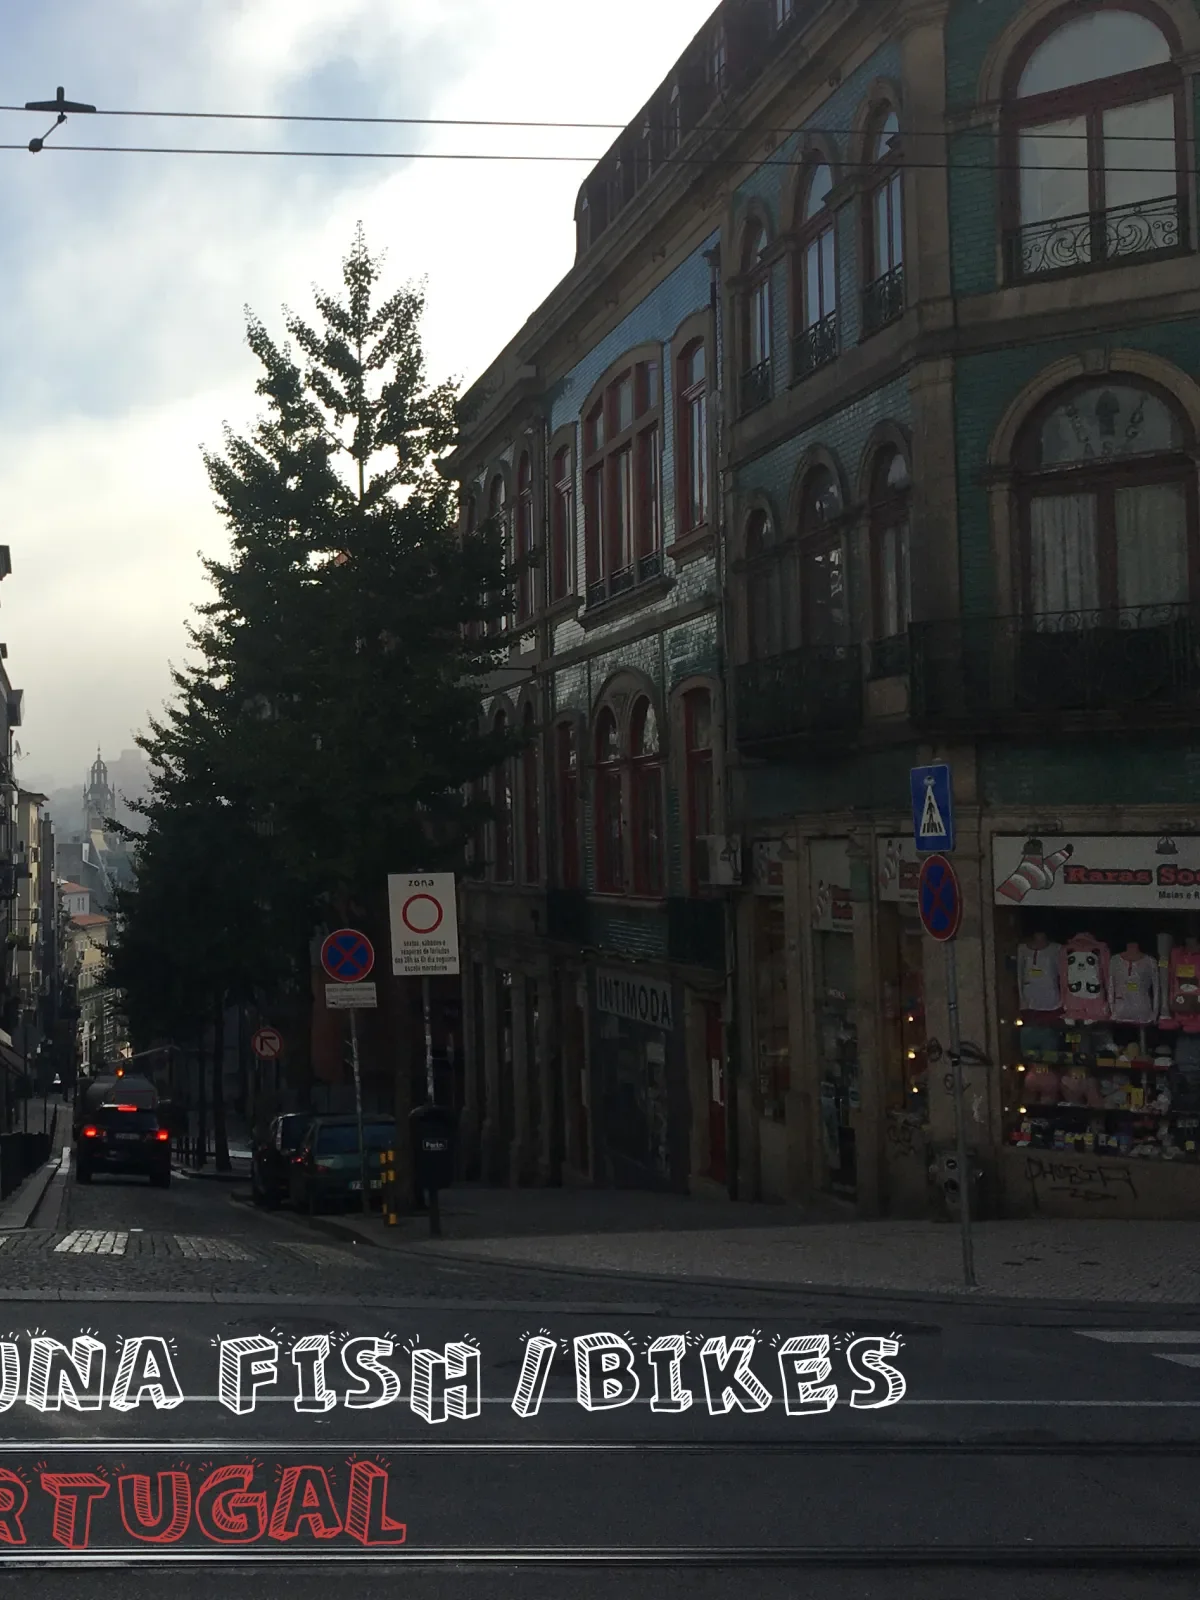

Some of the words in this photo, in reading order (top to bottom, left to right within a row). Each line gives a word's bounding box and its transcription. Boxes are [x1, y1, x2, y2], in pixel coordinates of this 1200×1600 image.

[408, 879, 435, 887] zona
[1063, 865, 1153, 886] Raras
[1157, 864, 1200, 886] So
[599, 975, 671, 1025] INTIMODA
